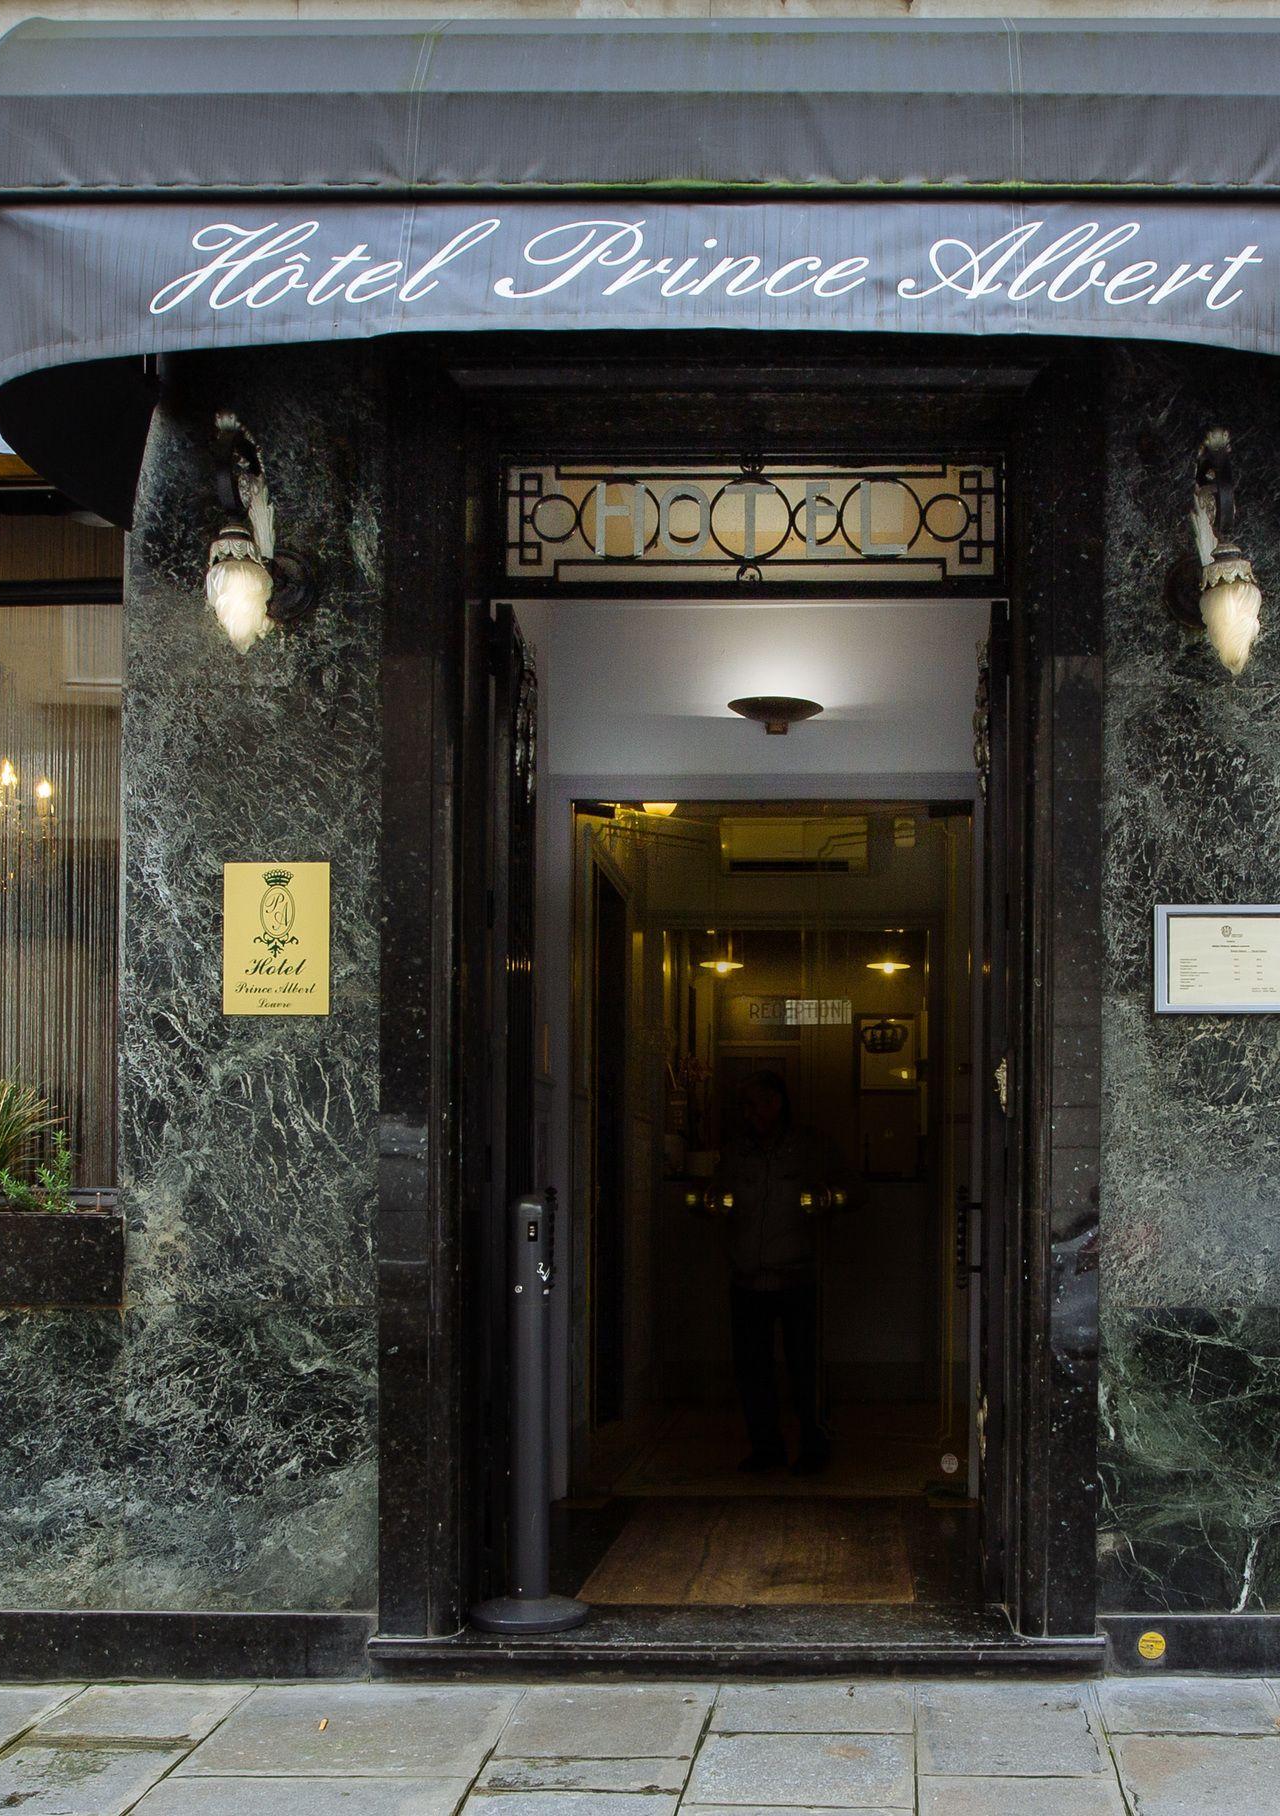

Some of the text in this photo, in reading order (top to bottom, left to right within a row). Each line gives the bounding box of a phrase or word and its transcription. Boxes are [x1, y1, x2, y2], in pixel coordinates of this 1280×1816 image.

[150, 218, 1264, 316] Hôtel Prince Albert
[595, 480, 908, 558] HOTEL
[235, 981, 316, 994] Prince Albert
[257, 998, 291, 1008] Louvre
